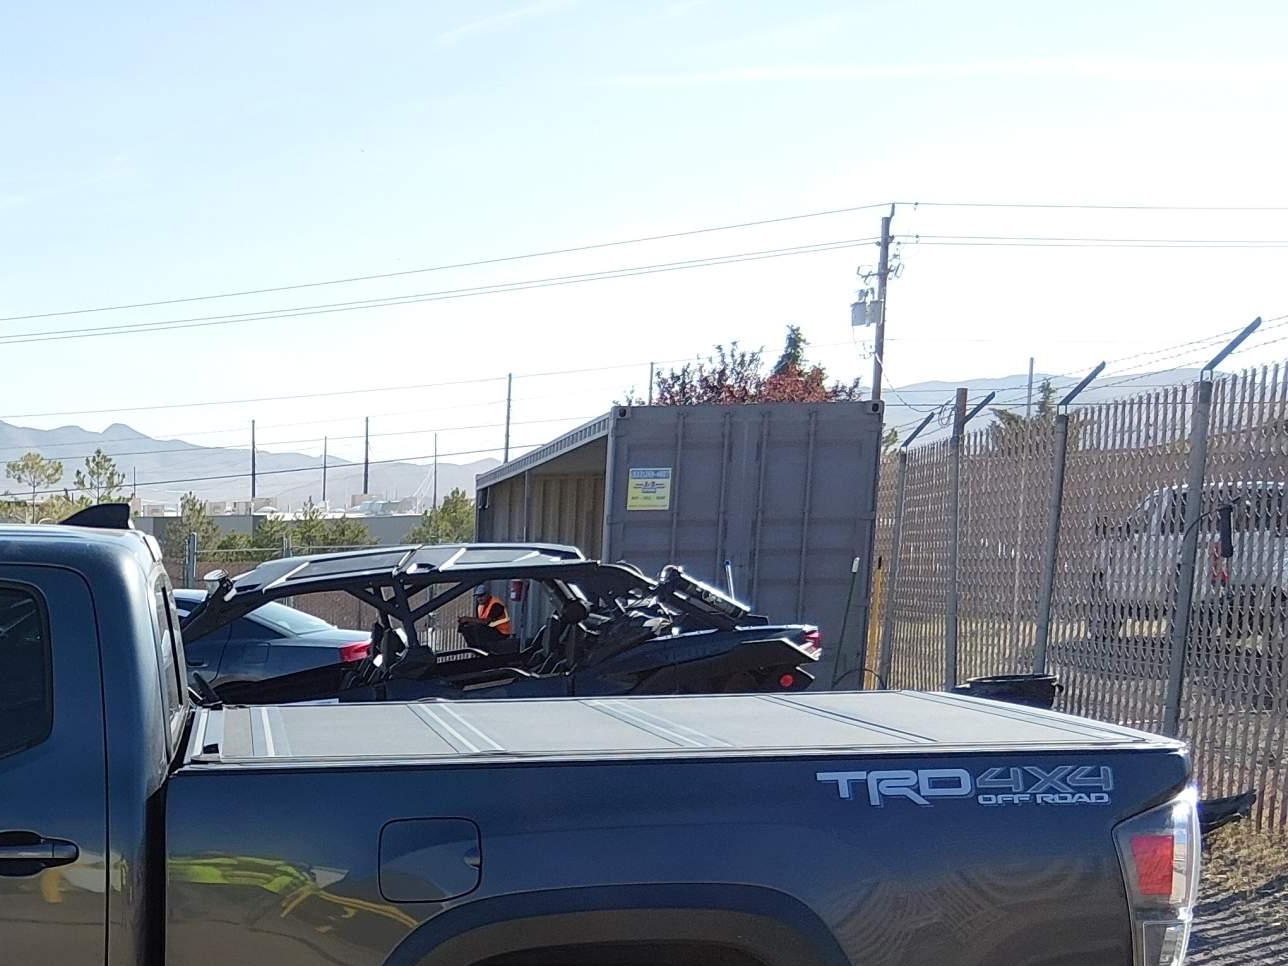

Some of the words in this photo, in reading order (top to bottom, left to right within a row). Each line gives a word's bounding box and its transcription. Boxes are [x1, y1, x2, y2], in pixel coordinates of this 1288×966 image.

[816, 768, 972, 805] TRD
[976, 765, 1114, 793] 4X4
[978, 793, 1029, 805] OFF
[1035, 792, 1111, 805] ROAD
